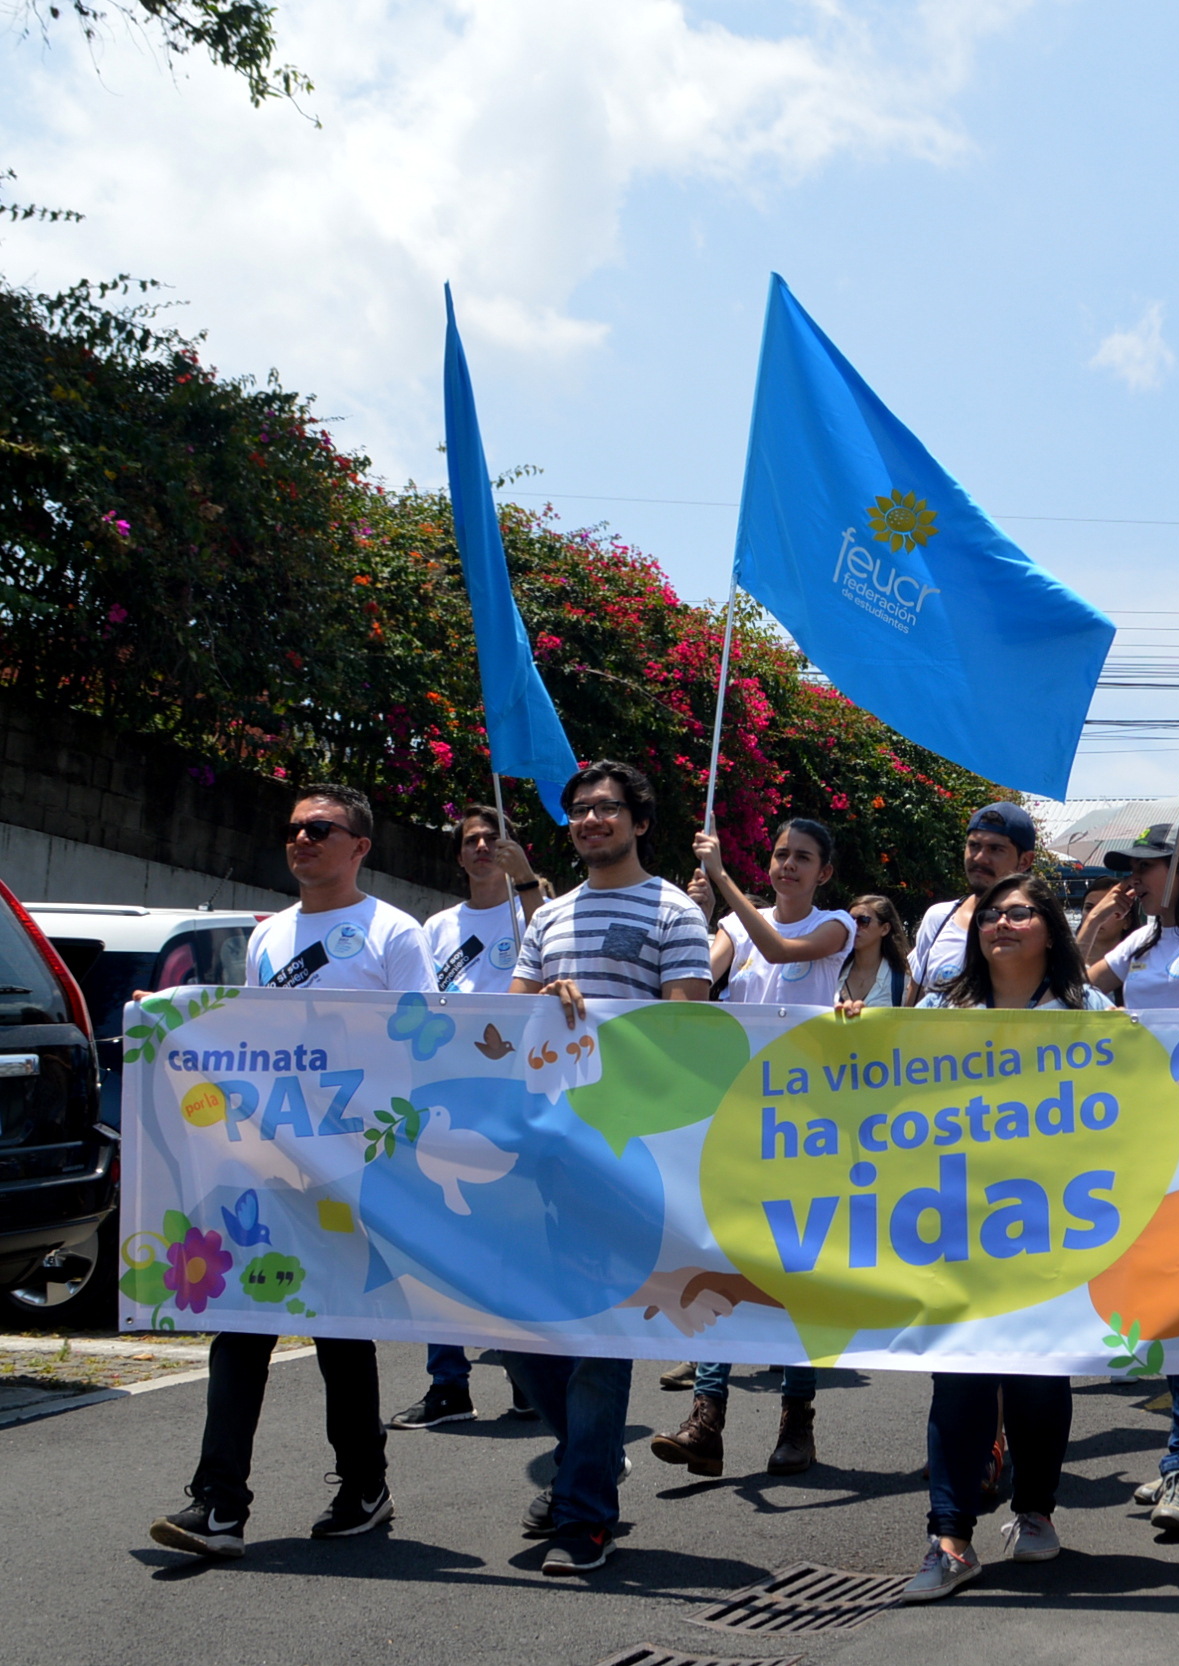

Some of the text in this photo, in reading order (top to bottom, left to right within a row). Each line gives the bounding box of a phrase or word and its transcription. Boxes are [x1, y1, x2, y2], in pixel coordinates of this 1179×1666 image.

[832, 527, 941, 613] feucr
[842, 588, 910, 634] de estudiantes
[843, 572, 917, 626] federación
[287, 957, 304, 973] soy
[450, 949, 465, 965] soy
[168, 1041, 328, 1072] caminata
[762, 1037, 1115, 1097] La violencia nos
[185, 1093, 219, 1117] por la
[214, 1069, 364, 1142] PAZ
[761, 1080, 1120, 1160] ha costado
[761, 1152, 1121, 1274] vidas
